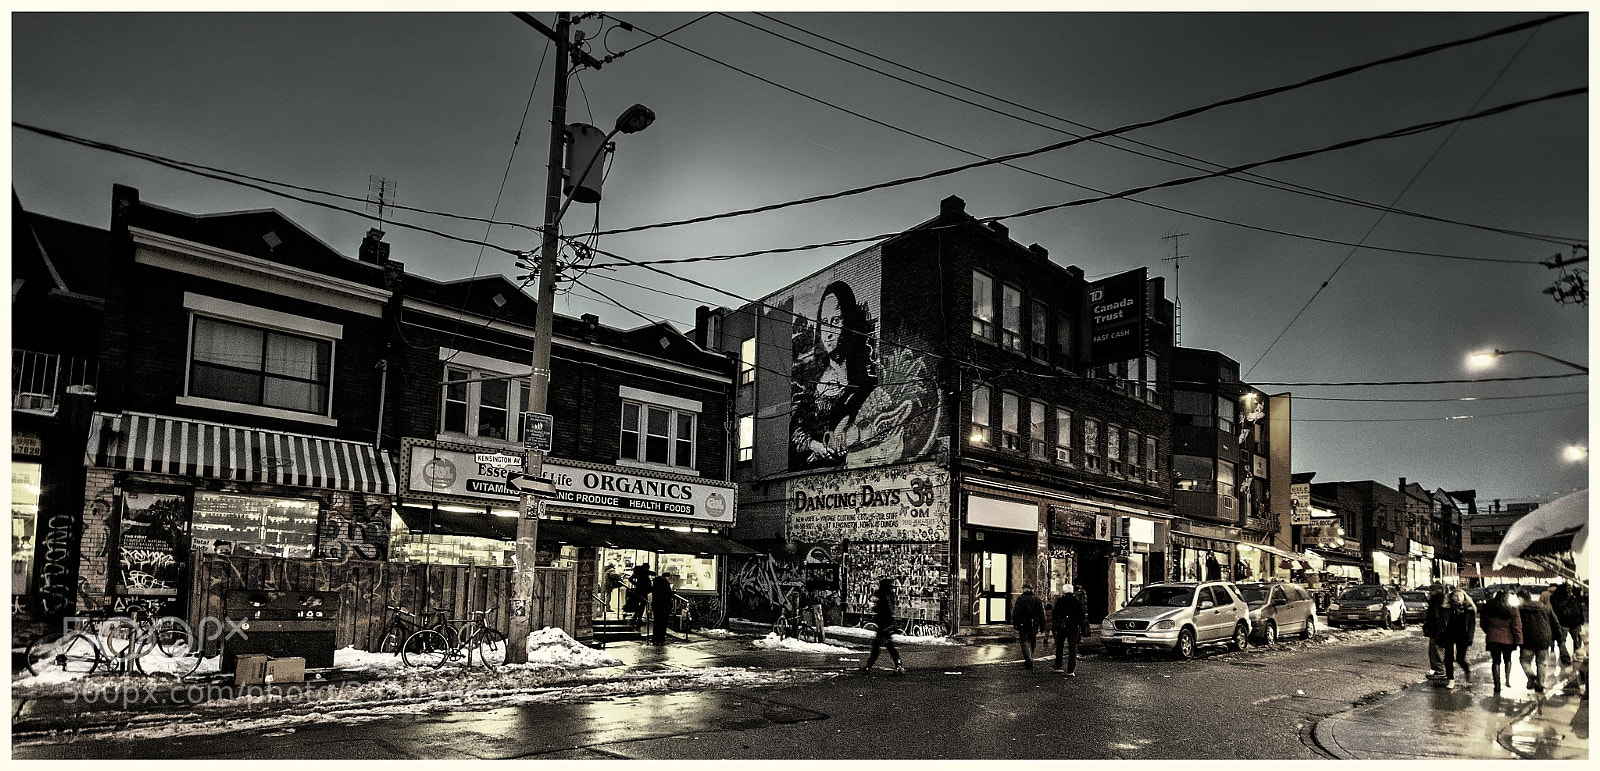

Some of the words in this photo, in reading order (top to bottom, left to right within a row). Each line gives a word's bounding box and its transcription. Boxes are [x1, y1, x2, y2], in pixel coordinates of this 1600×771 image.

[1090, 290, 1103, 302] TD
[1093, 298, 1134, 314] Canada
[1094, 310, 1124, 324] Trust
[1093, 333, 1110, 343] FAST
[1111, 329, 1130, 339] CASH
[477, 454, 512, 464] KENSINGTON
[583, 473, 693, 500] ORGANICS
[576, 494, 619, 506] PRODUCE
[629, 500, 661, 510] HEALTH
[664, 503, 692, 514] FOODS
[795, 491, 857, 511] DANCING
[860, 485, 901, 507] DAYS
[910, 508, 930, 518] OM
